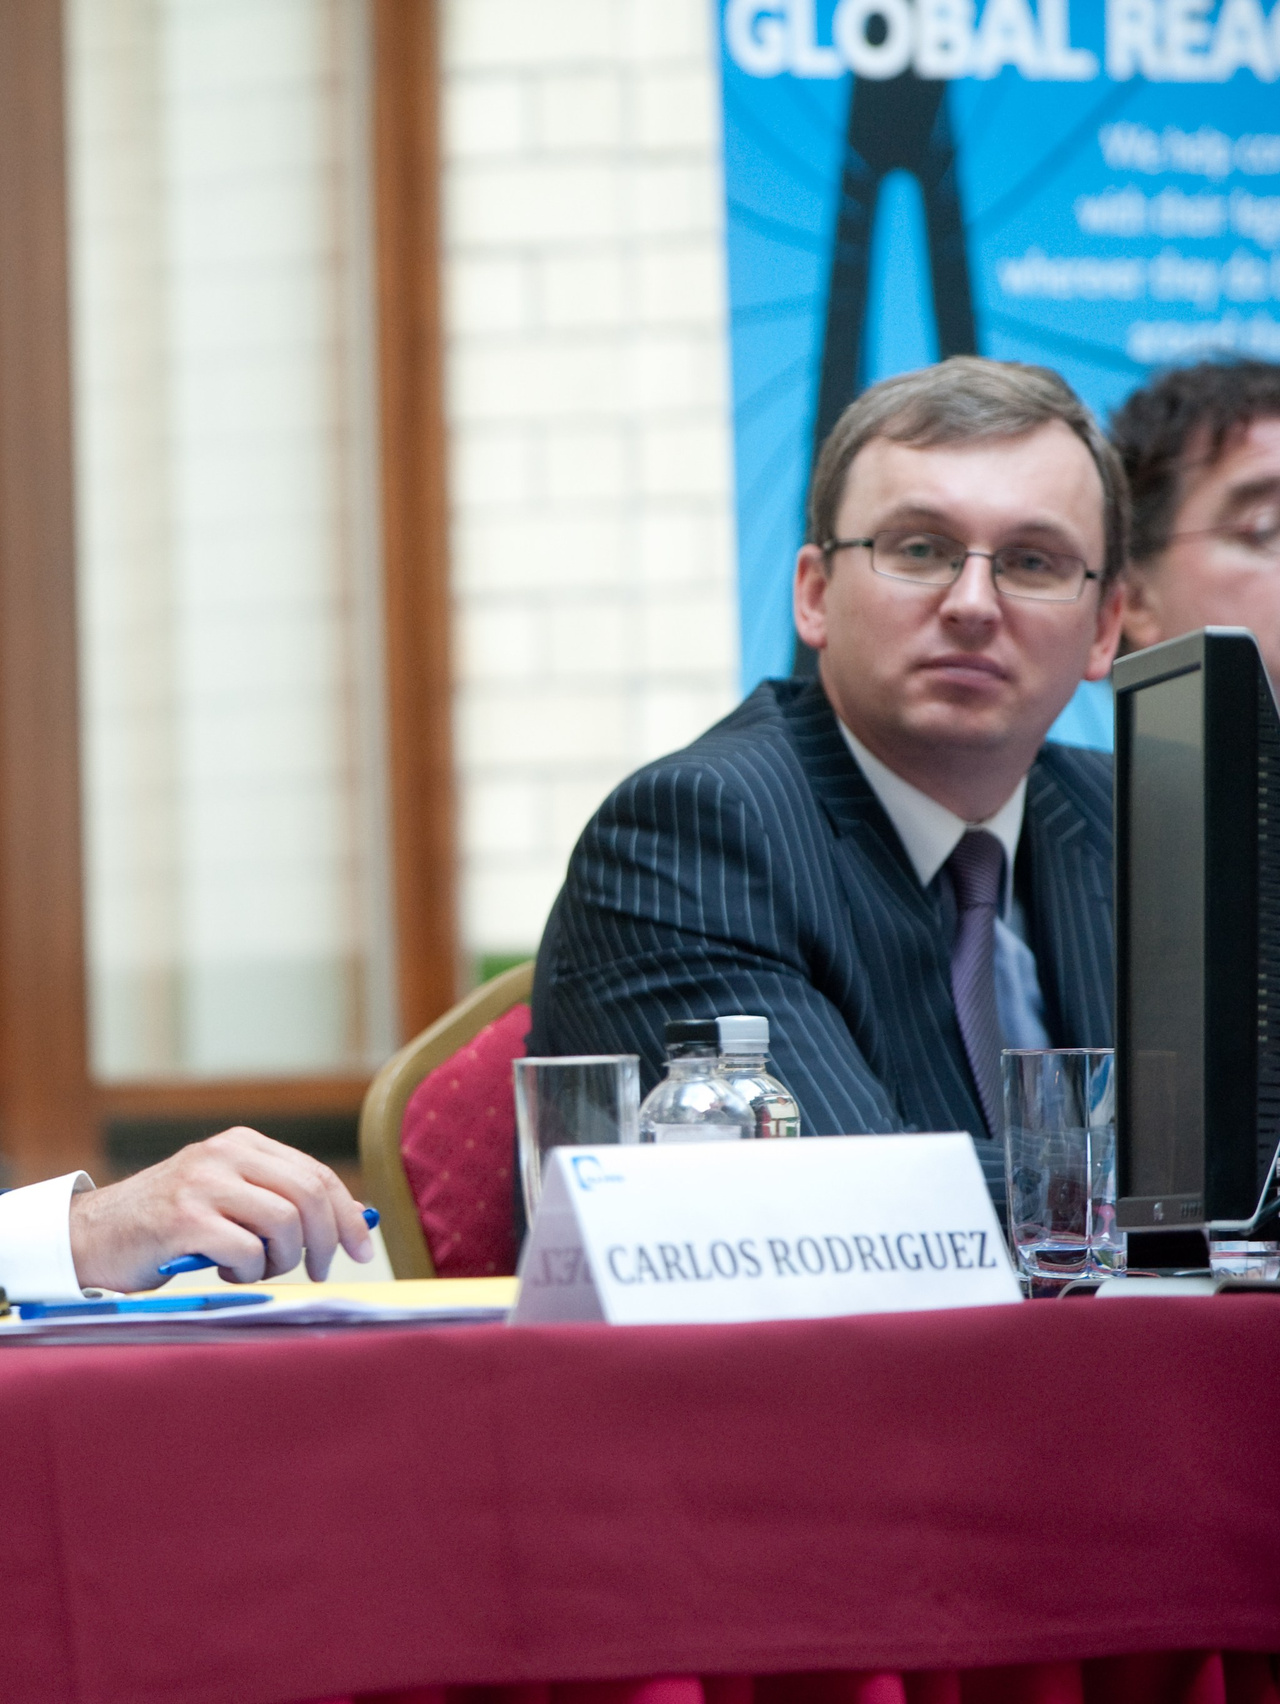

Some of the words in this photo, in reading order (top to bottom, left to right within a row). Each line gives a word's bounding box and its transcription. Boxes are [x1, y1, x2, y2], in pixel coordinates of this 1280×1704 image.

[723, 0, 1099, 81] GLOBAL
[1105, 0, 1280, 83] REA
[607, 1238, 762, 1286] CARLOS
[767, 1230, 998, 1278] RODRIGUEZ
